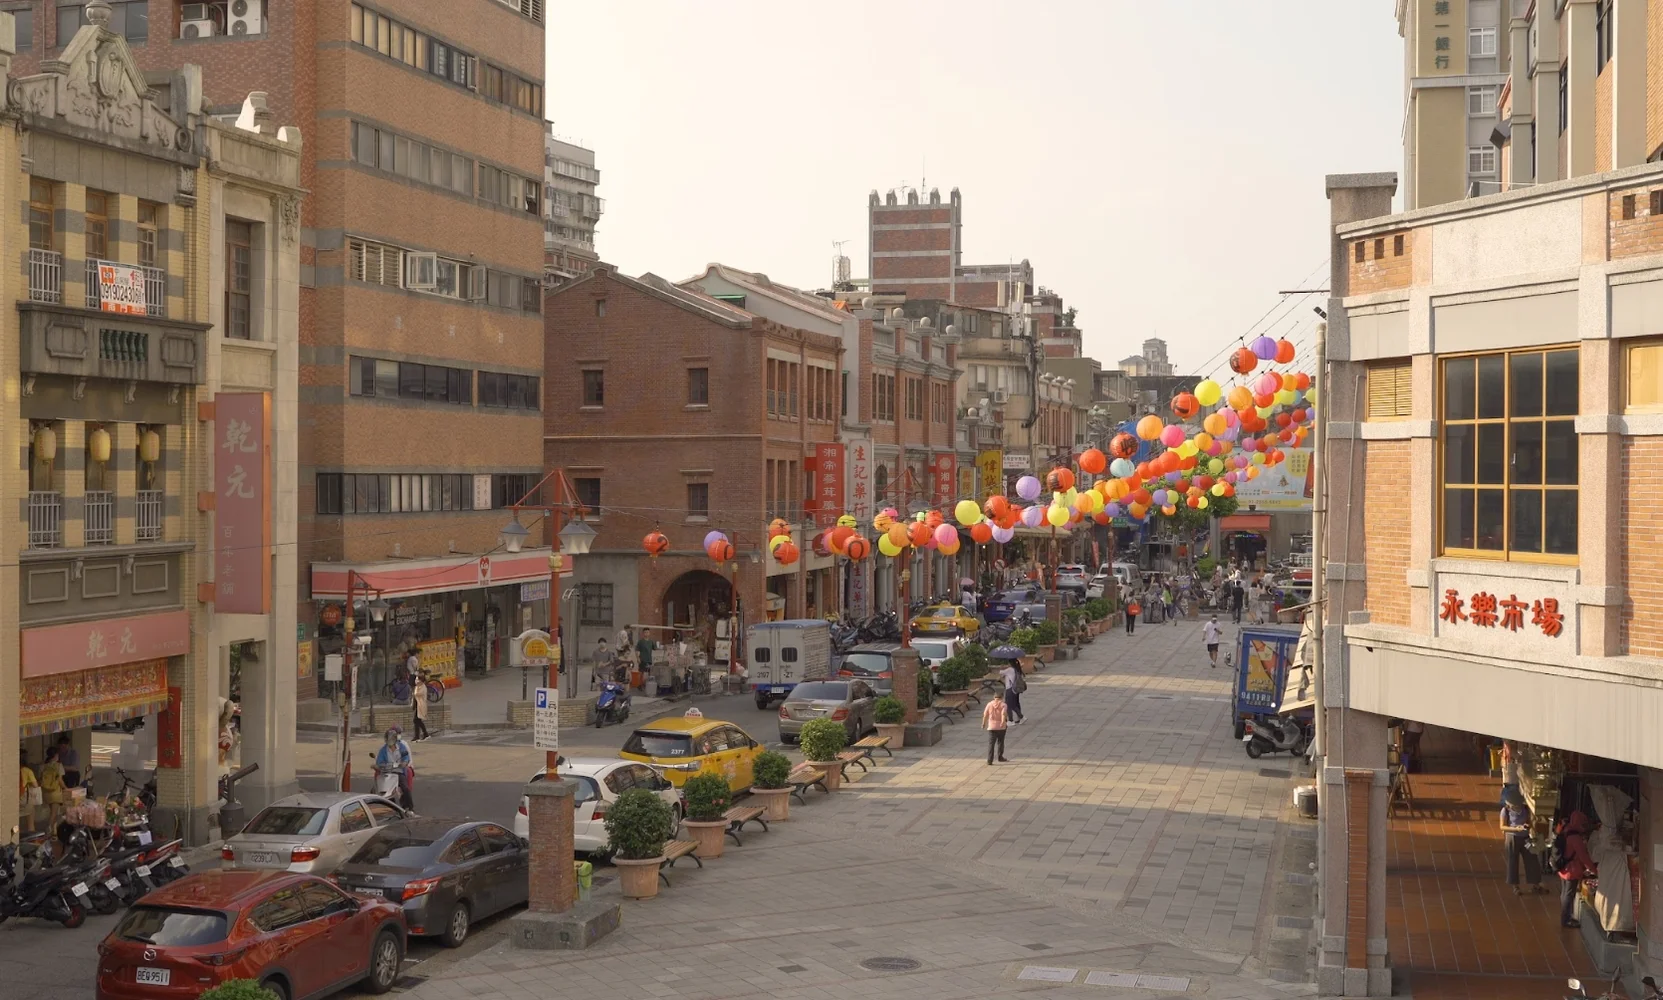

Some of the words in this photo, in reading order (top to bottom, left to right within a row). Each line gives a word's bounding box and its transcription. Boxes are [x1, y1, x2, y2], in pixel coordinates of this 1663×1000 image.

[1434, 1, 1449, 69] 第一銀行
[222, 418, 257, 498] 乾元
[853, 446, 868, 517] 生記藥行
[1439, 588, 1565, 638] 永樂市場
[86, 626, 137, 660] 乾元
[537, 692, 545, 706] P
